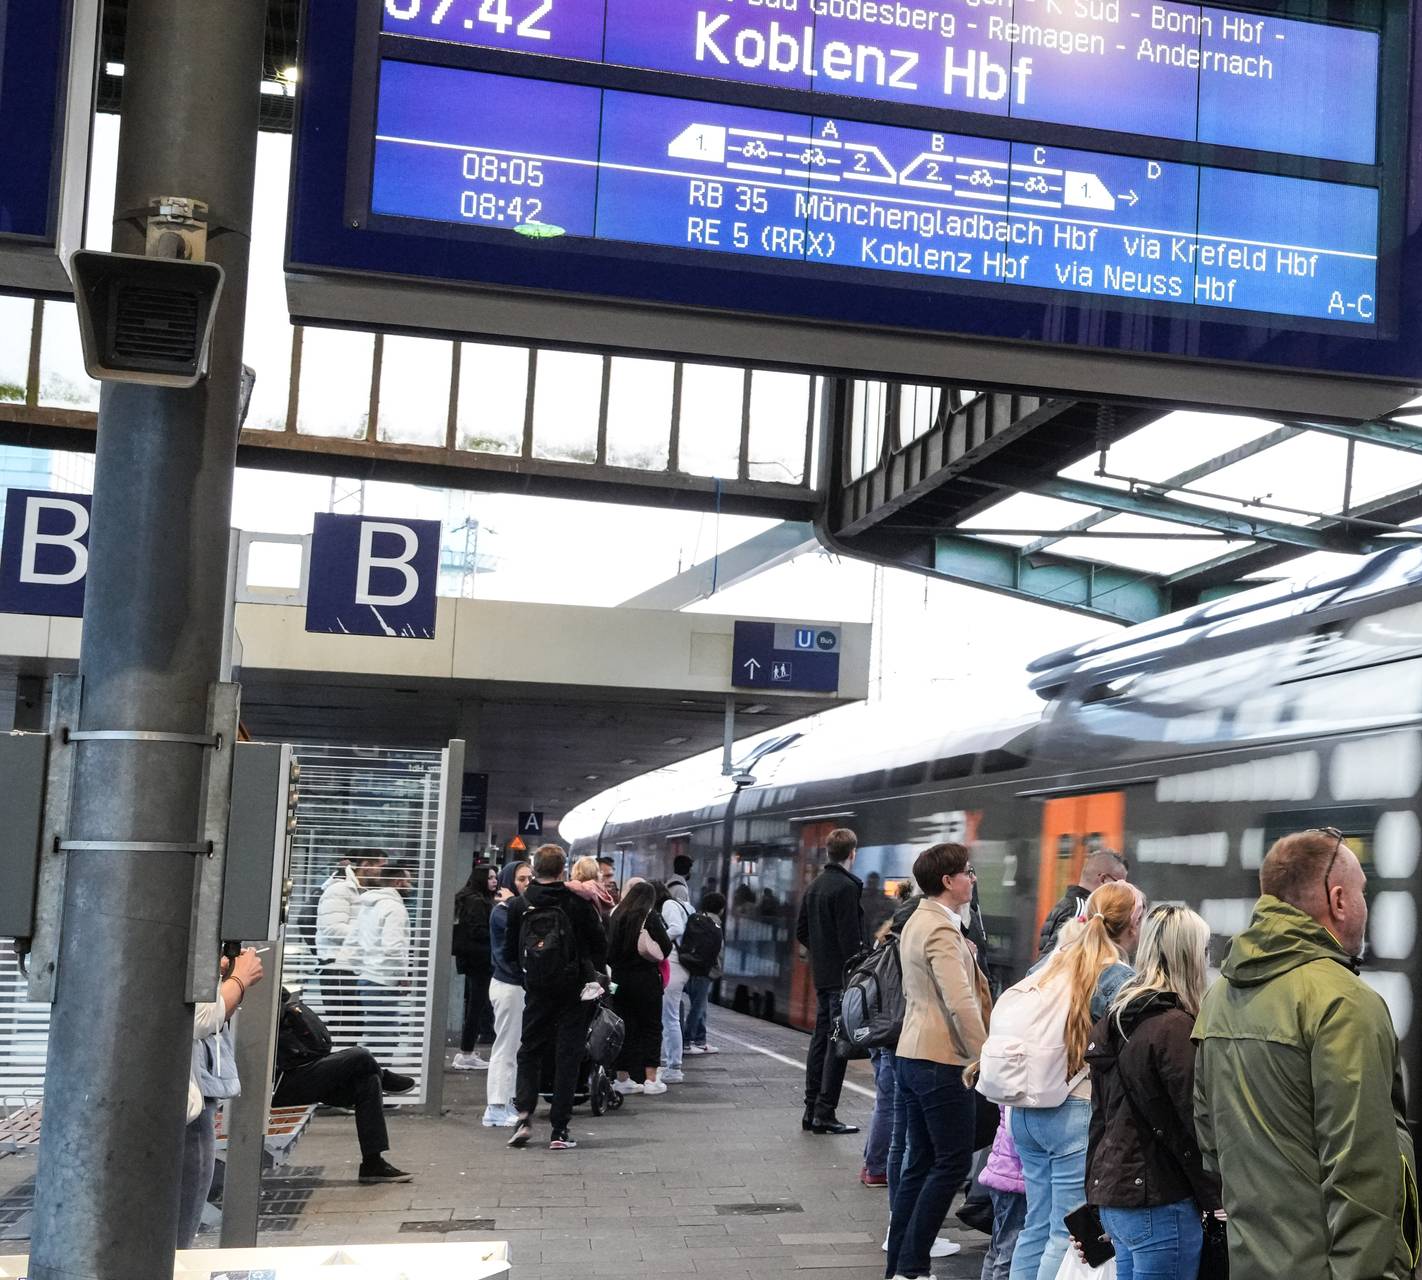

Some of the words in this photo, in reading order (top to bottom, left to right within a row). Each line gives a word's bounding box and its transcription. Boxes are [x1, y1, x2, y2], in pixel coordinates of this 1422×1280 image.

[810, 0, 956, 37] Godesberg
[988, 16, 1105, 55] Remagen
[1137, 38, 1273, 79] Andernach
[1151, 6, 1213, 37] Bonn
[1222, 16, 1264, 44] Hbf
[695, 11, 919, 90] Koblenz
[943, 46, 1032, 104] Hbf
[822, 120, 838, 138] A
[931, 134, 945, 152] B
[462, 153, 543, 187] 08:05
[853, 153, 871, 172] 2.
[1034, 147, 1046, 165] C
[1148, 161, 1162, 179] D
[926, 163, 943, 182] 2.
[460, 191, 542, 224] 08:42
[689, 180, 723, 208] RB
[735, 186, 768, 214] 35
[794, 193, 1043, 246] Mönchengladbach
[1053, 224, 1098, 252] Hbf
[1123, 235, 1161, 260] via
[1171, 238, 1267, 272] Krefeld
[1276, 250, 1319, 277] Hbf
[687, 217, 720, 245] RE
[733, 222, 749, 248] 5
[761, 226, 836, 258] (RRX)
[861, 237, 972, 274] Koblenz
[983, 251, 1030, 279] Hbf
[1055, 261, 1093, 287] via
[1104, 264, 1183, 297] Neuss
[1194, 274, 1237, 303] Hbf
[1327, 291, 1373, 318] A-C
[19, 496, 90, 585] B
[354, 520, 420, 606] B
[798, 631, 811, 647] U
[820, 636, 833, 645] Bus
[524, 813, 540, 830] A
